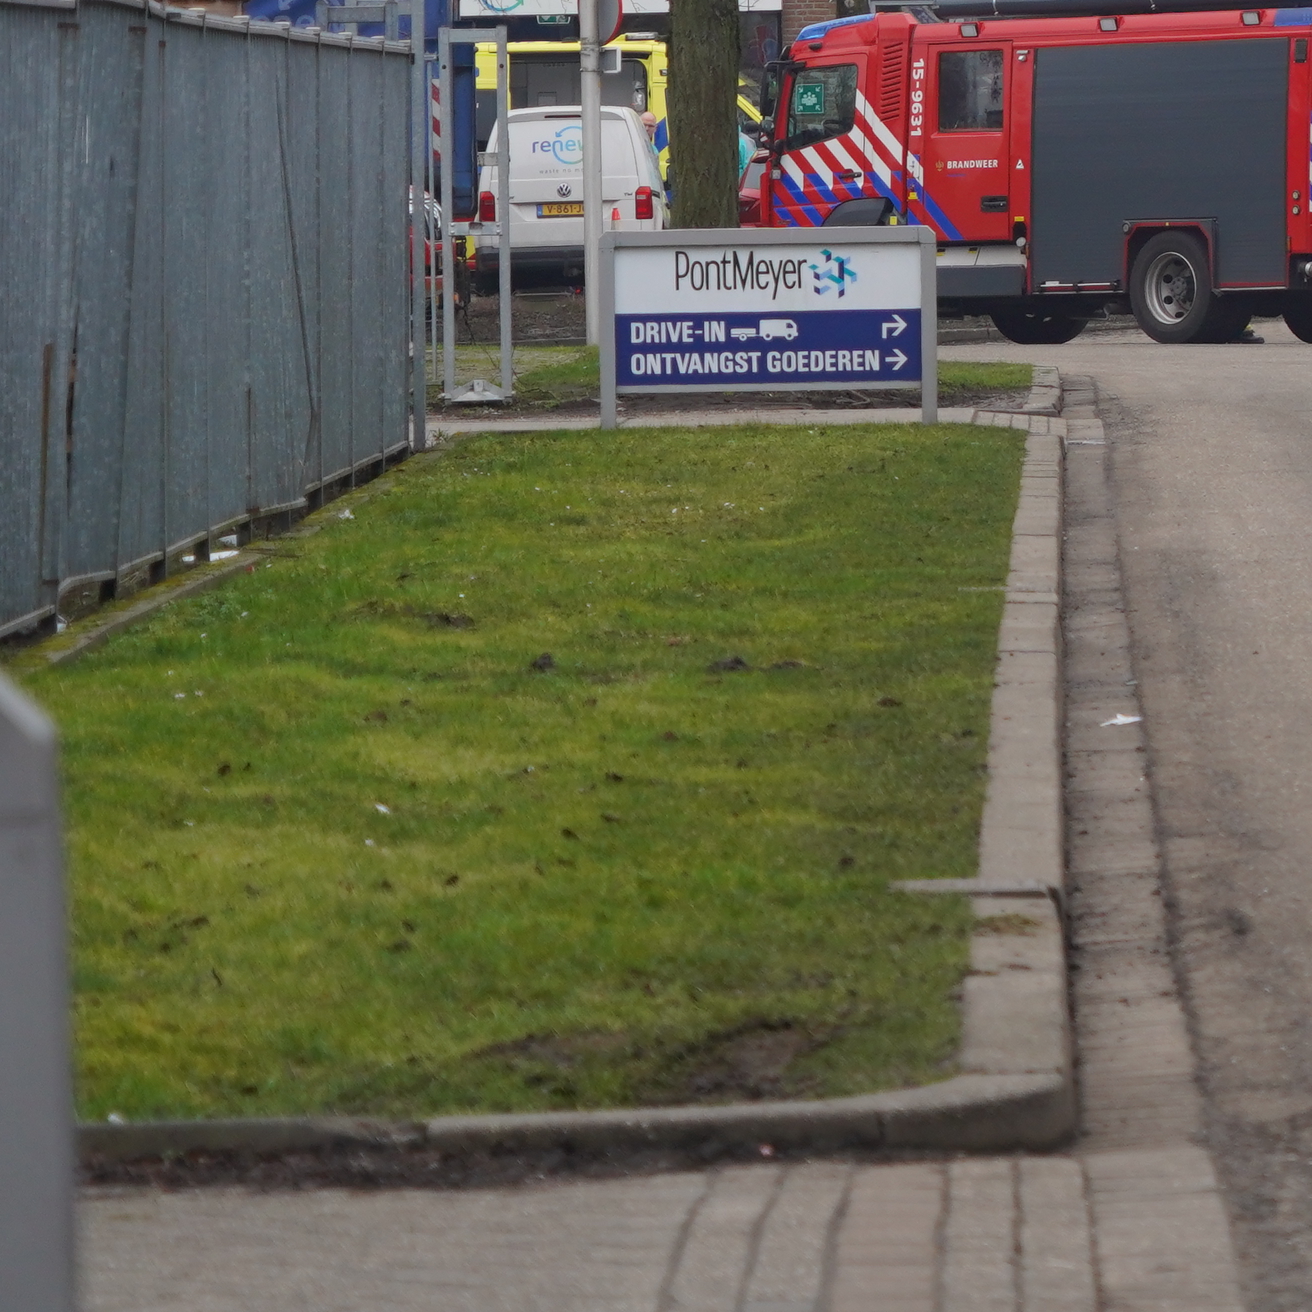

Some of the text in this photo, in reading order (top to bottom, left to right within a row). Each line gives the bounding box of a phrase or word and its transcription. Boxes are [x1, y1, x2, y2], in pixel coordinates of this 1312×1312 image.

[911, 58, 924, 136] 15-9631
[947, 159, 998, 169] BRANDWEER
[674, 250, 807, 300] PontMeyer
[630, 320, 725, 344] DRIVE-IN
[630, 349, 880, 375] ONTVANGST GOEDEREN
